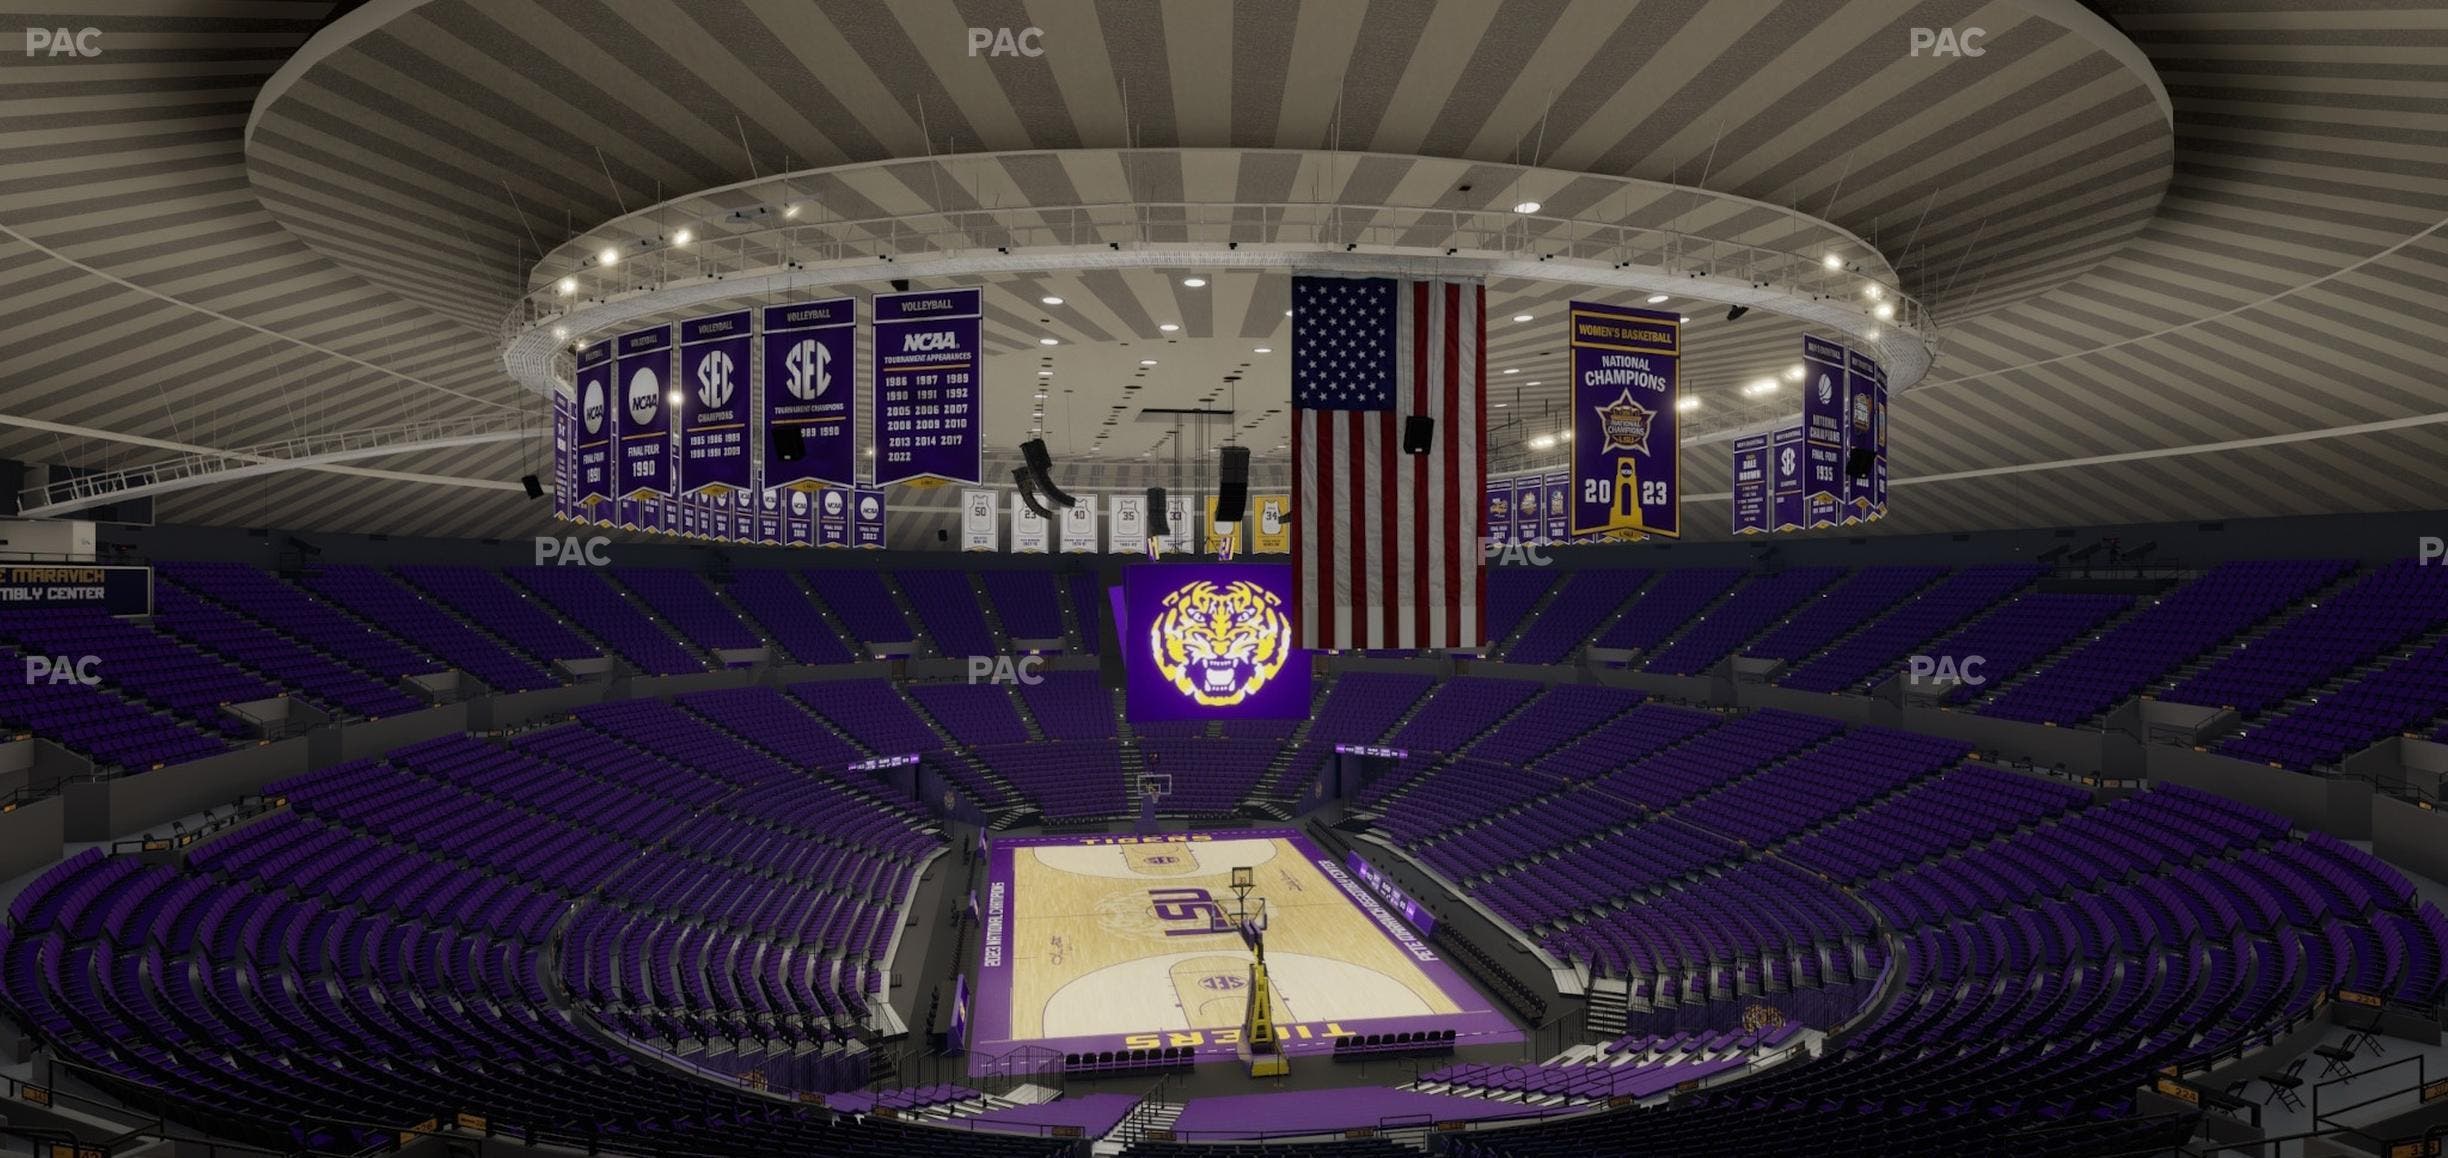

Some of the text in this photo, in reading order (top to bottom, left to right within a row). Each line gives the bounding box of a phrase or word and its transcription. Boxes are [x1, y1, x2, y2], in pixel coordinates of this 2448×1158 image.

[901, 299, 953, 312] VOLLEYBALL
[786, 309, 831, 322] VOLLEYBALL
[698, 320, 734, 334] VOLLEYBALL
[1579, 324, 1672, 344] WOMEN'S BASKETBALL
[903, 331, 956, 352] NCAA
[884, 352, 972, 364] TOURNAMENT APPEARANCES
[1602, 355, 1650, 371] NATIONAL
[785, 339, 832, 400] SEC
[697, 350, 734, 409] SEC
[886, 374, 969, 387] 1986 1987 1989
[1585, 369, 1666, 392] CHAMPIONS
[886, 388, 968, 401] 1990 1991 1992
[632, 394, 657, 411] NCAA
[774, 403, 844, 414] TOURNAMENT CHAMPIONS
[698, 410, 734, 423] CHAMPIONS
[886, 404, 968, 416] 2005 2006 2007
[888, 418, 968, 431] 2008 2009 2010
[1608, 424, 1644, 436] CHAMPIONS
[800, 426, 840, 438] 989 1990
[889, 435, 962, 447] 2013 2014 2017
[628, 444, 660, 457] FINAL FOUR
[888, 452, 912, 462] 2022
[1812, 448, 1838, 462] FINAL FOUR
[632, 460, 656, 477] 1990
[1782, 448, 1796, 476] SEC
[1816, 465, 1834, 481] 1935
[1585, 478, 1667, 504] 20 23
[974, 506, 986, 516] 50
[1024, 510, 1036, 519] 23
[1074, 510, 1086, 520] 40
[1122, 511, 1134, 521] 35
[1266, 512, 1278, 520] 34
[12, 568, 105, 583] MARAVICH
[47, 587, 105, 600] CENTER
[1148, 888, 1230, 936] LSU
[986, 914, 1003, 946] NATIONAL
[984, 946, 1002, 967] 2023
[1404, 940, 1440, 962] PETE
[1202, 975, 1246, 990] SEC
